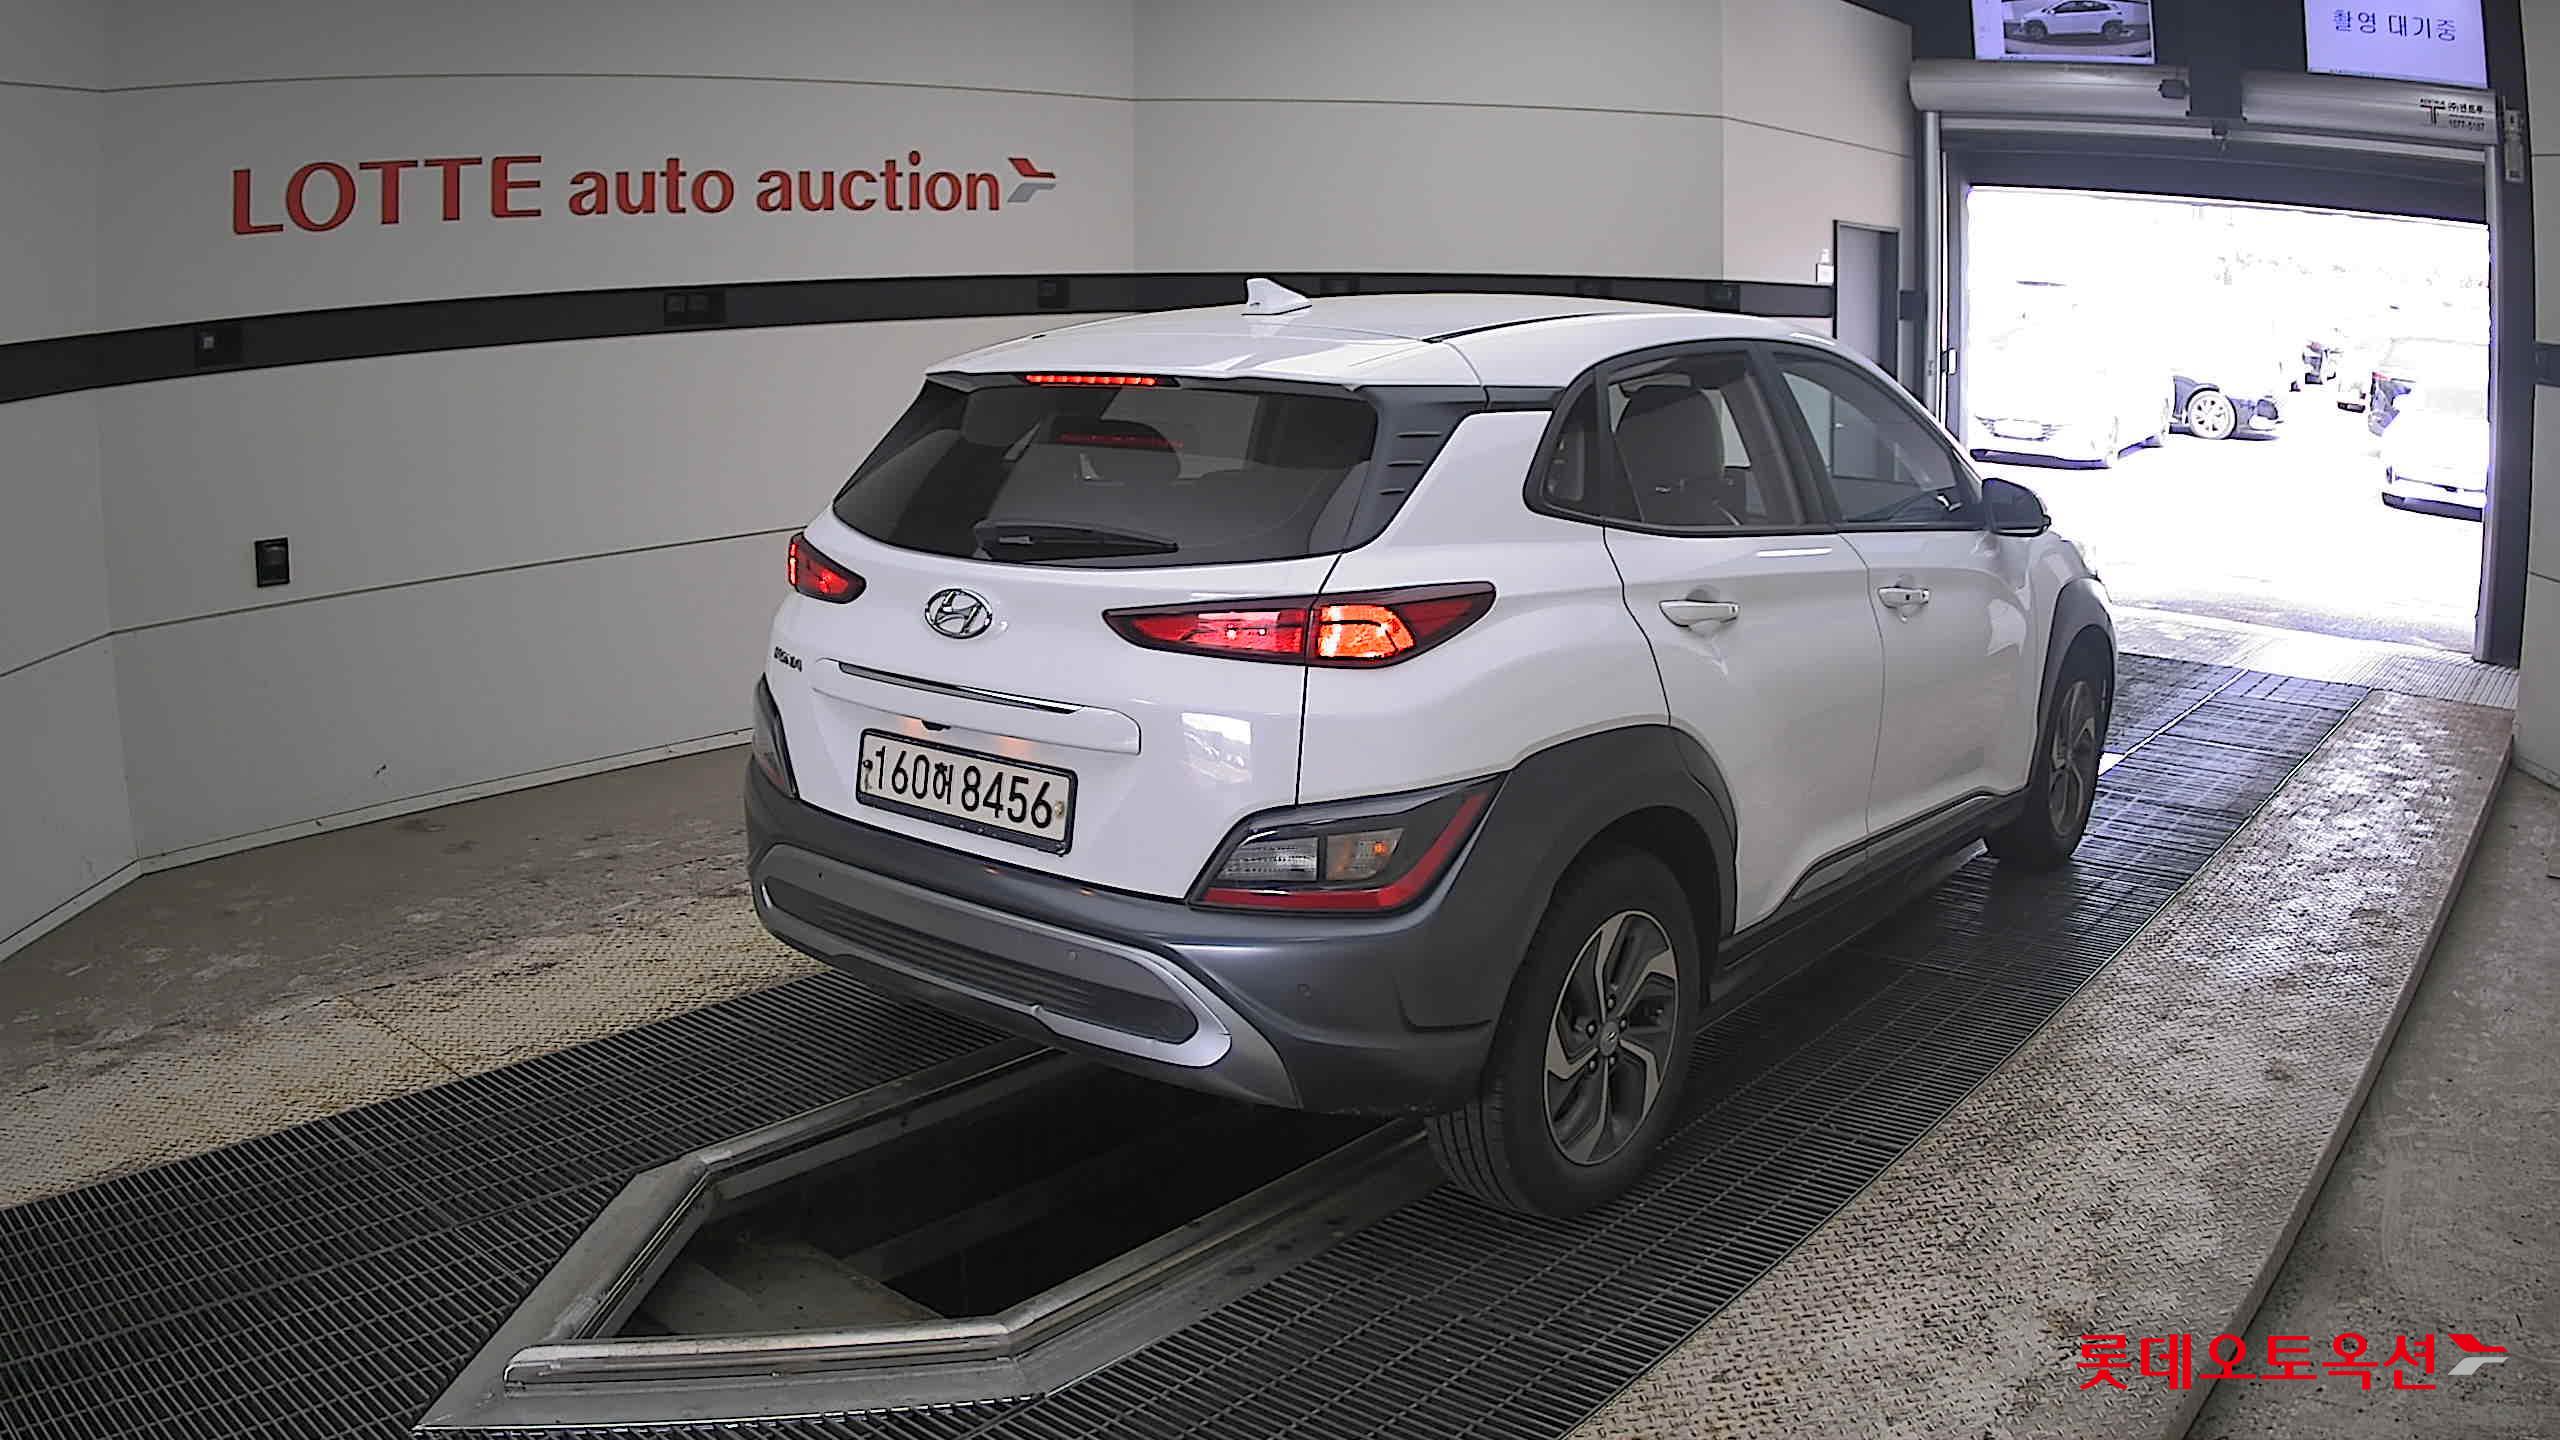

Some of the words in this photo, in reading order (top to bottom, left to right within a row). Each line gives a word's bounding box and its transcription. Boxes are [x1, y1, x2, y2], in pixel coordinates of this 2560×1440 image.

[2388, 15, 2456, 41] 대기중
[233, 155, 541, 234] LOTTE
[568, 157, 734, 216] auto
[756, 150, 1000, 212] auction
